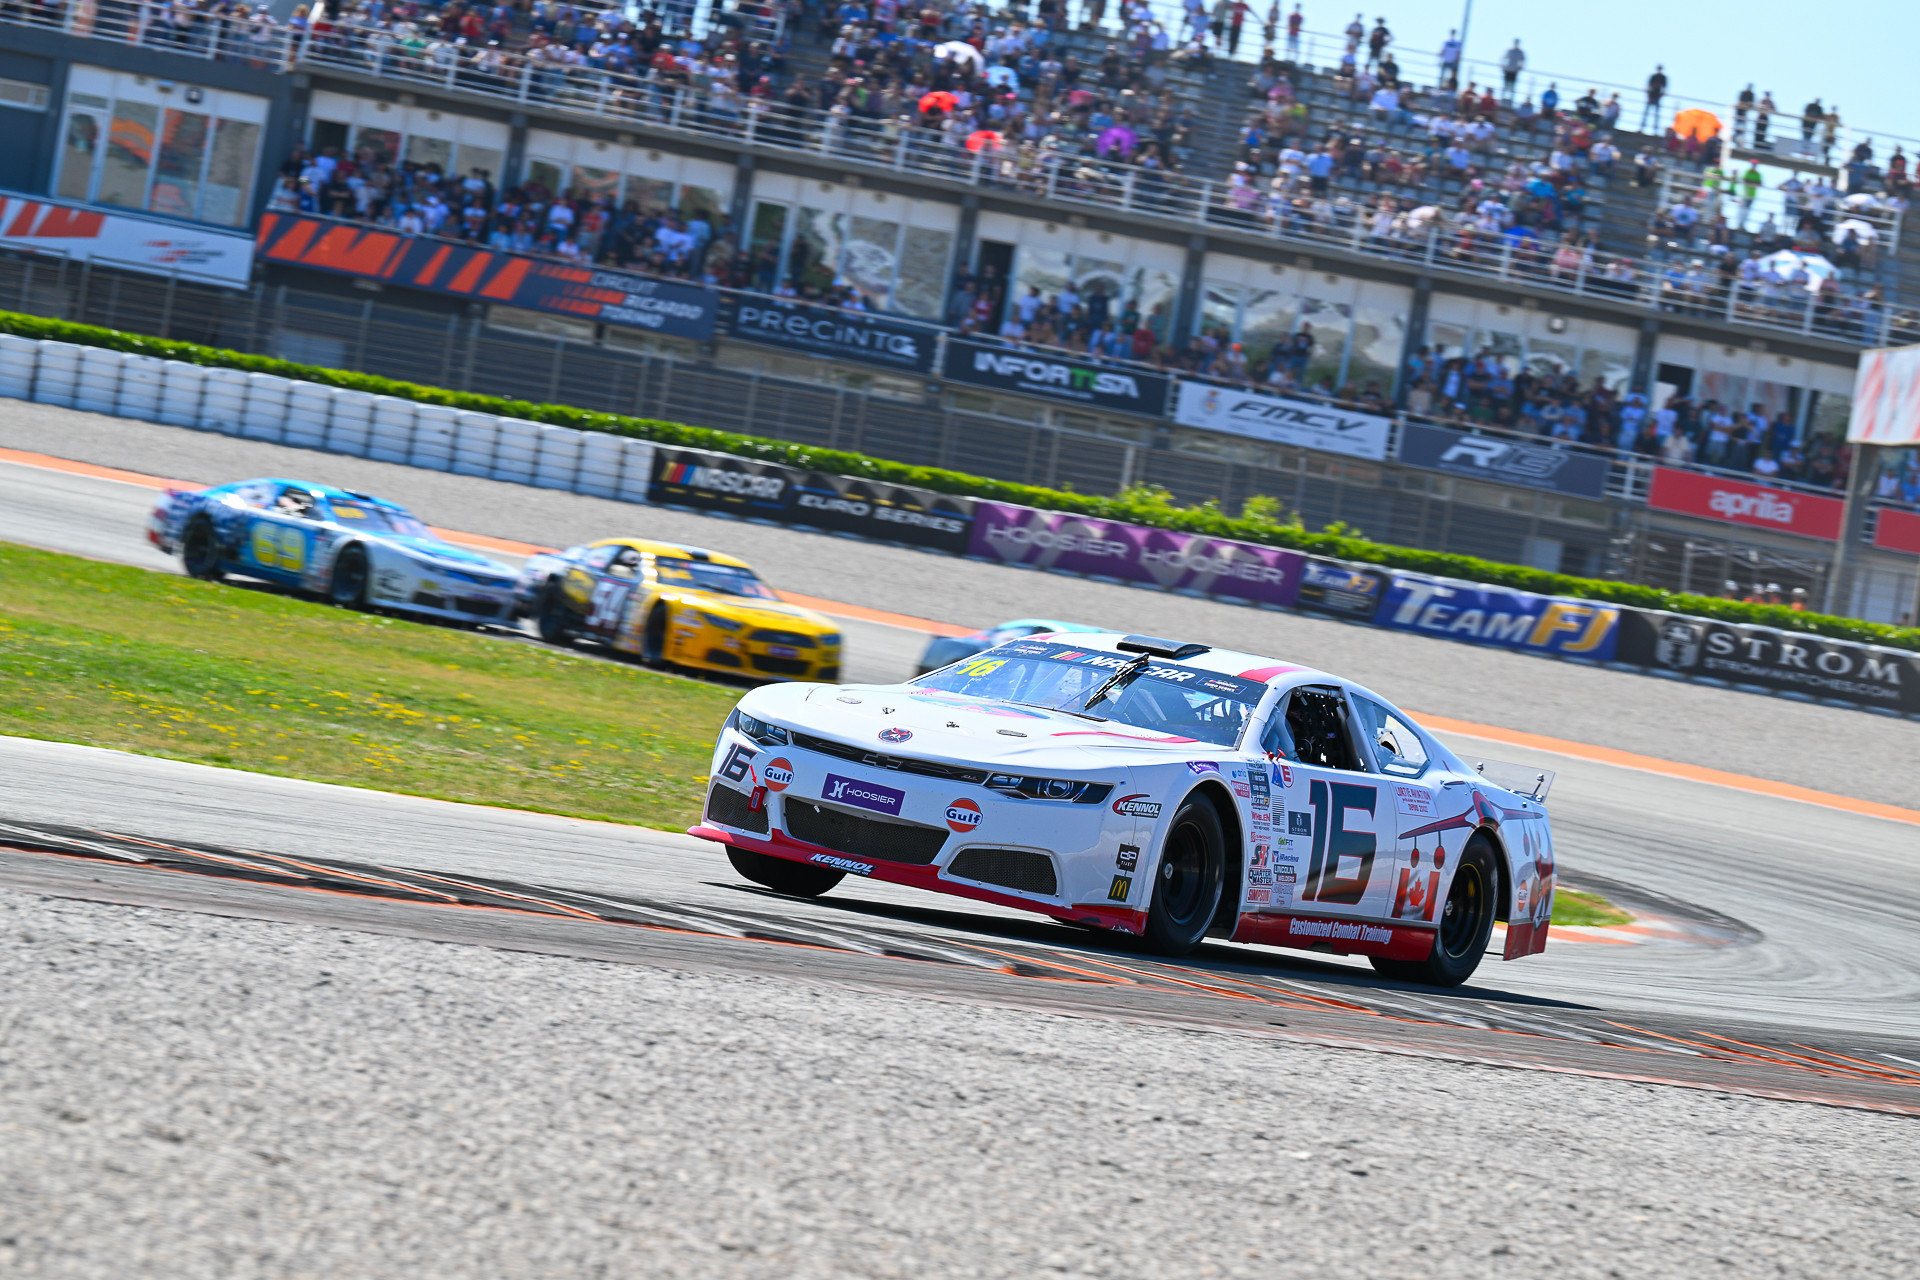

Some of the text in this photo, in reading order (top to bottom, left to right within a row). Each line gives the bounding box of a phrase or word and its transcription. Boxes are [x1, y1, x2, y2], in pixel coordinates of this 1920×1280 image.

[590, 271, 659, 295] CIRCUIT
[601, 304, 665, 328] TORMO
[624, 294, 703, 320] RICARDO
[974, 351, 1139, 398] INFORTISA
[1231, 400, 1367, 431] FMCV
[688, 465, 785, 499] NASCAR
[798, 493, 965, 533] EURO SERIES
[1709, 490, 1795, 524] aprilia
[253, 520, 305, 573] 69
[984, 523, 1128, 559] HOOSIER
[1139, 546, 1285, 585] HOOSIER
[956, 658, 1005, 677] 16
[1705, 631, 1903, 685] STROM
[718, 742, 757, 783] 16
[765, 768, 793, 783] Gulf
[1281, 765, 1291, 782] E
[846, 787, 896, 806] HOOSIER
[1117, 801, 1160, 814] KENNOL
[945, 808, 982, 824] Gulf
[1301, 778, 1378, 905] 16
[810, 853, 873, 873] KENNOL
[1274, 865, 1294, 875] LINCOLN
[1248, 889, 1270, 902] SIMPSON
[1289, 918, 1392, 944] Customized Combat Training
